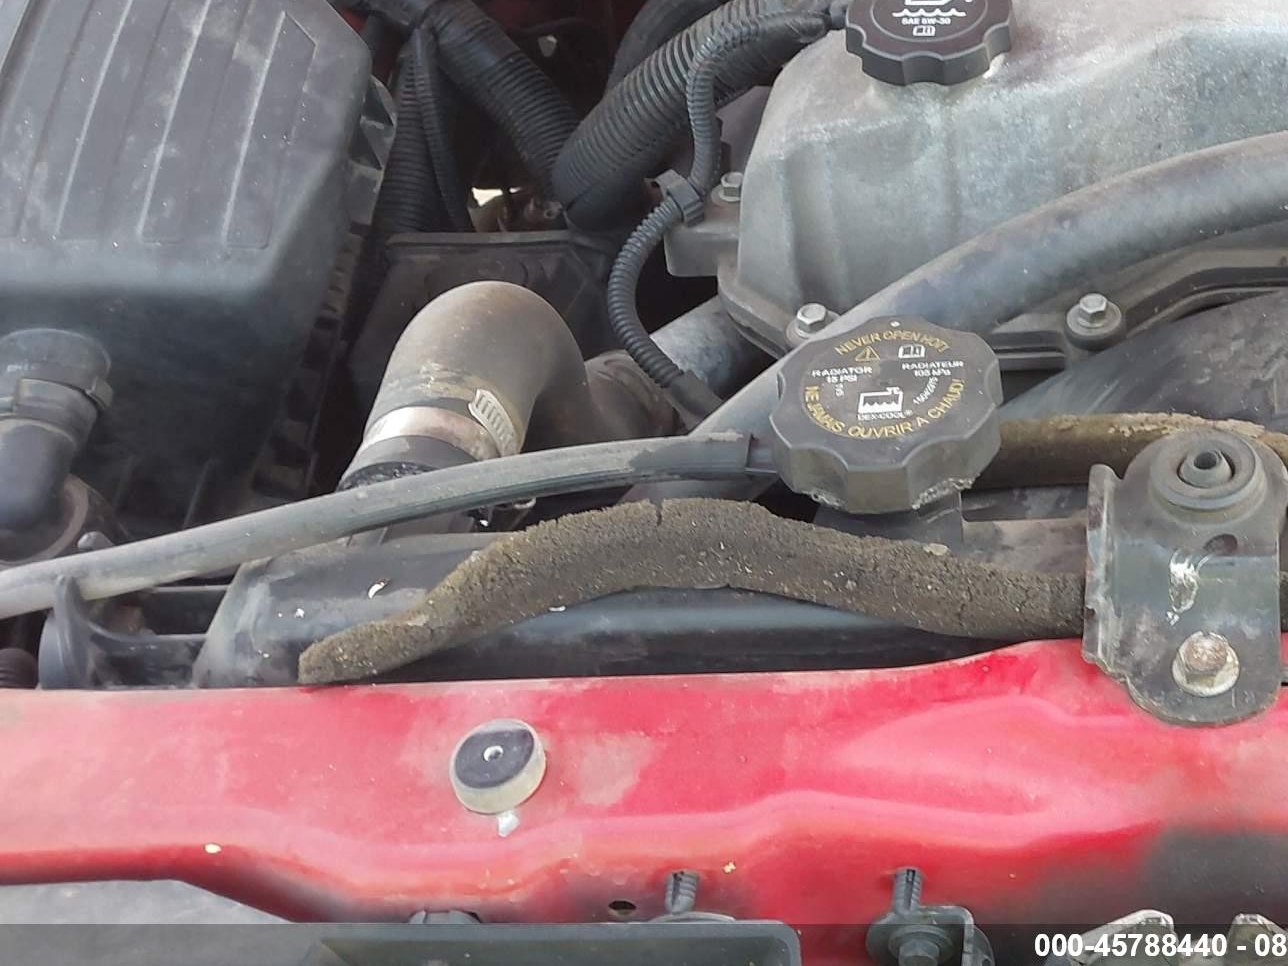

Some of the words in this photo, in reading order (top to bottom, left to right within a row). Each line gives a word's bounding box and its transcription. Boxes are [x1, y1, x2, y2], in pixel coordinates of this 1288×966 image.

[902, 17, 919, 25] SAE
[921, 17, 951, 25] 5W-30
[834, 330, 882, 355] NEVER
[882, 329, 923, 342] OPEN
[811, 365, 873, 377] RADIATOR
[902, 360, 964, 370] RADIATEUR
[806, 402, 846, 433] JAMAIS
[847, 421, 914, 440] OUVRIR
